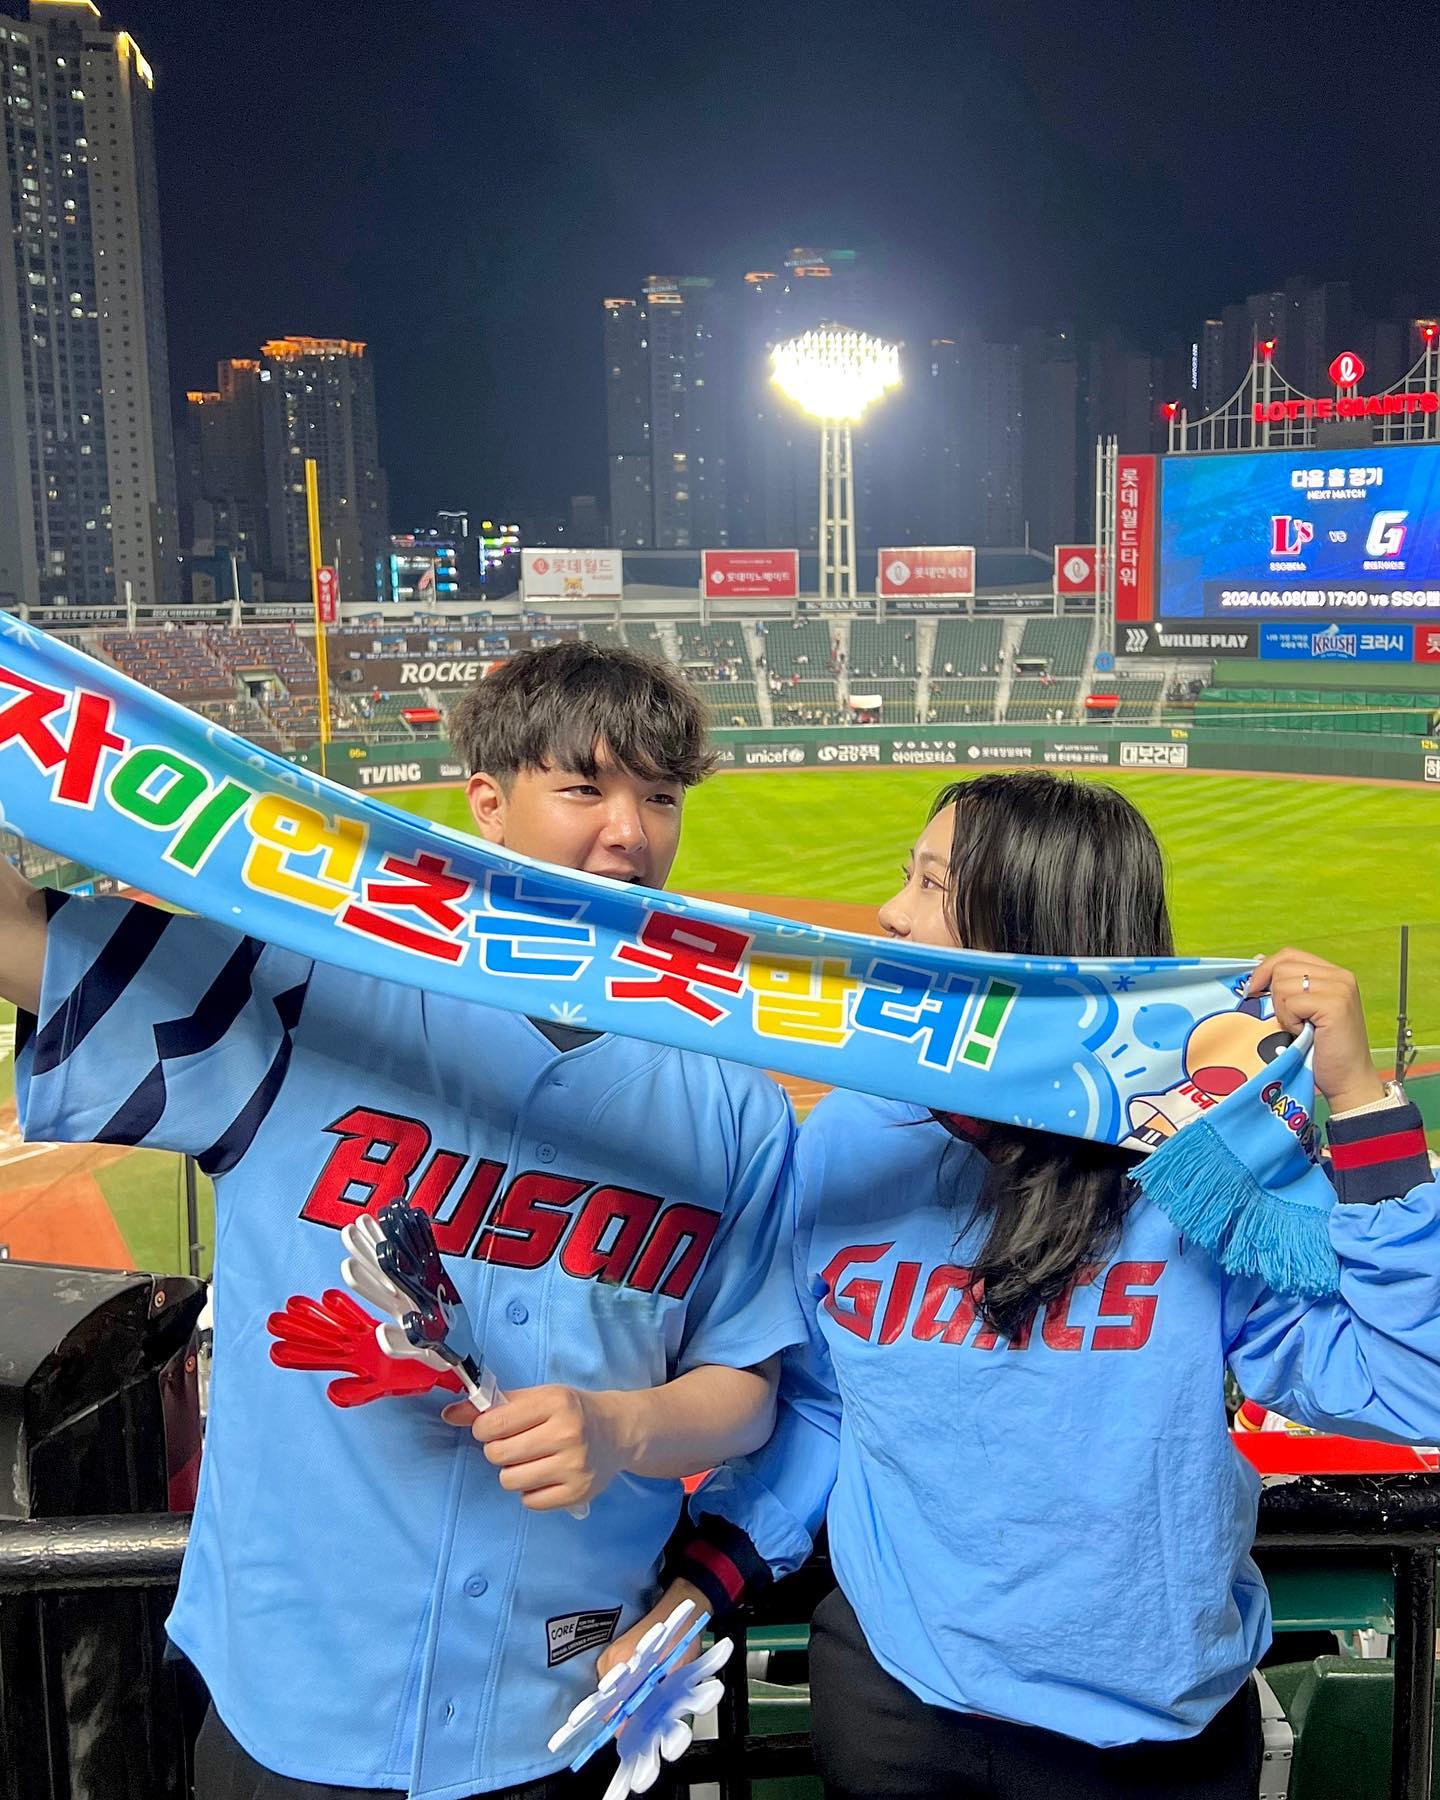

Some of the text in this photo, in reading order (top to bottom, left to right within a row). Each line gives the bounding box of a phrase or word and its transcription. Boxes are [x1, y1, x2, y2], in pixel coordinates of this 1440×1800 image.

[1254, 392, 1438, 423] LOTTE GIANTS
[1291, 467, 1383, 488] 다음 홈 경기
[1307, 489, 1366, 500] NEXT MATCH
[552, 558, 614, 574] 롯데월드
[1327, 590, 1368, 607] 17:00
[1312, 635, 1356, 656] KRUSH
[1360, 634, 1403, 651] 크러시
[401, 662, 490, 683] ROCKET
[892, 741, 956, 750] VOLVO
[746, 748, 788, 764] unicef
[892, 750, 956, 764] 아이언모터스
[1123, 745, 1185, 766] 대보건설
[359, 763, 421, 785] TVING
[821, 1241, 1168, 1352] GIATS
[551, 1623, 575, 1640] CORE
